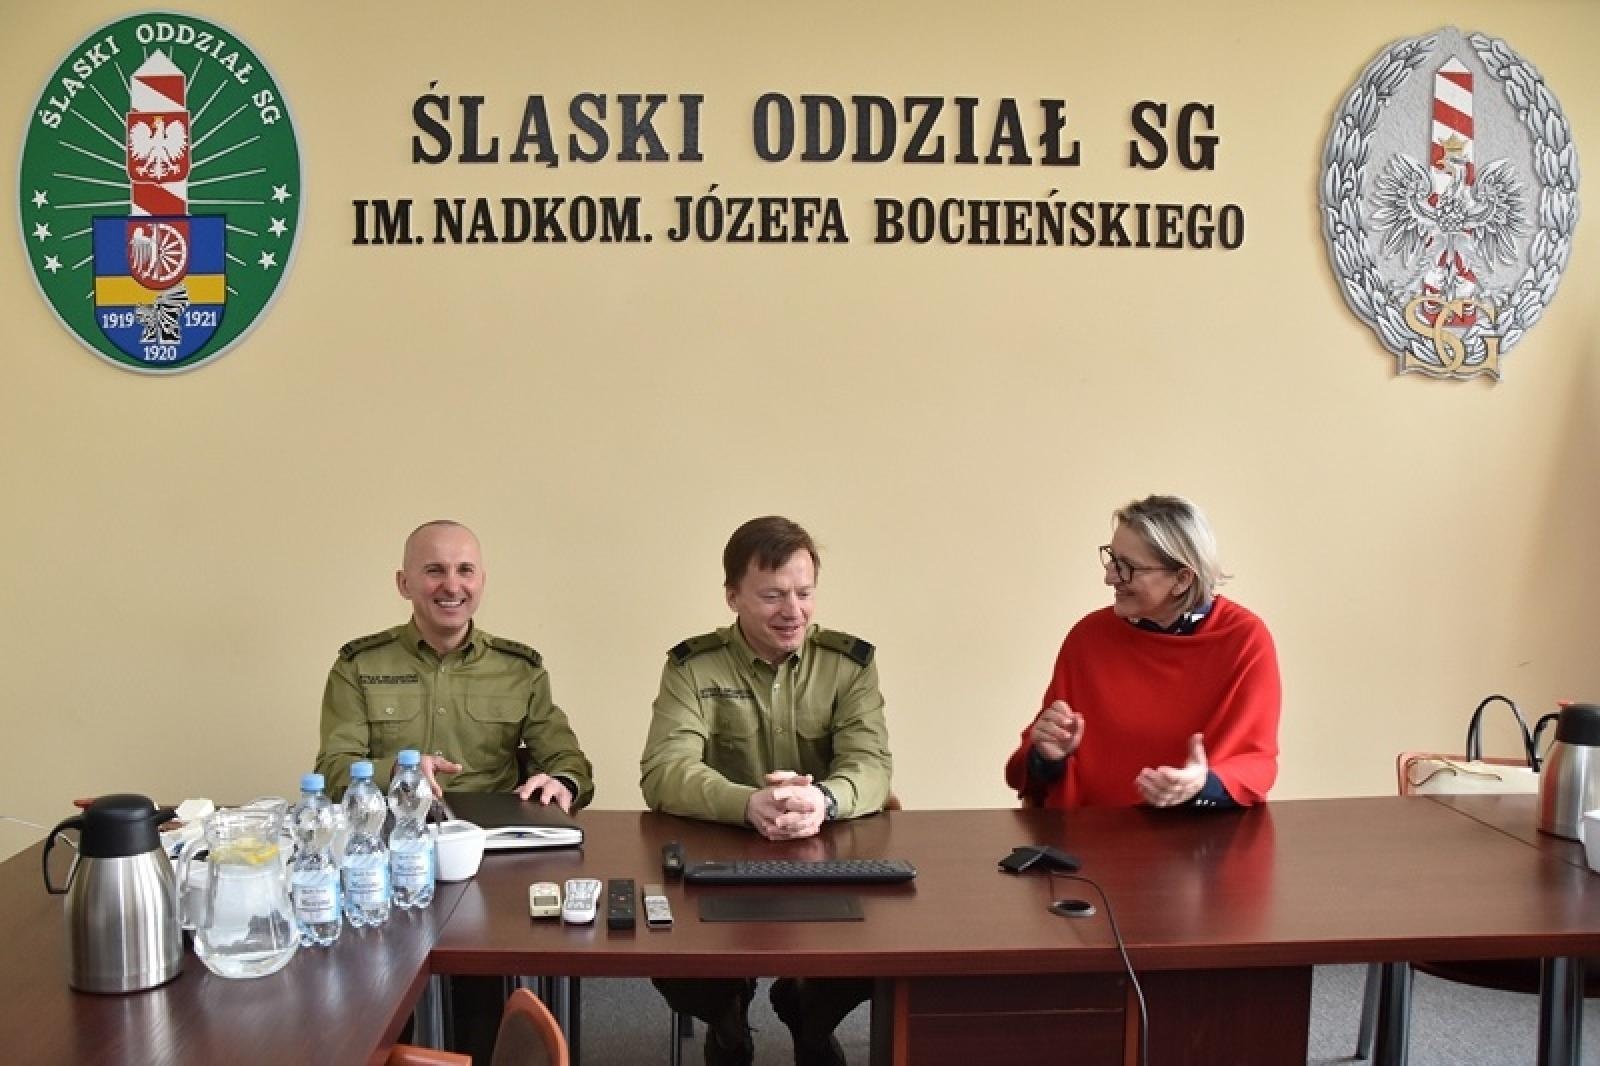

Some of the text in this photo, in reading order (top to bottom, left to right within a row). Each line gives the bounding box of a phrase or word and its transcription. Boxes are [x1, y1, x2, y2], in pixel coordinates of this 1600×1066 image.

[252, 89, 281, 125] SG
[411, 80, 1220, 171] ŚLĄSKI ODDZIAŁ SG
[352, 183, 1246, 251] IM. NADKOM. JÓZEFA BOCHEŃSKIEGO
[102, 311, 135, 329] 1919
[185, 311, 217, 327] 1921
[143, 345, 177, 361] 1920
